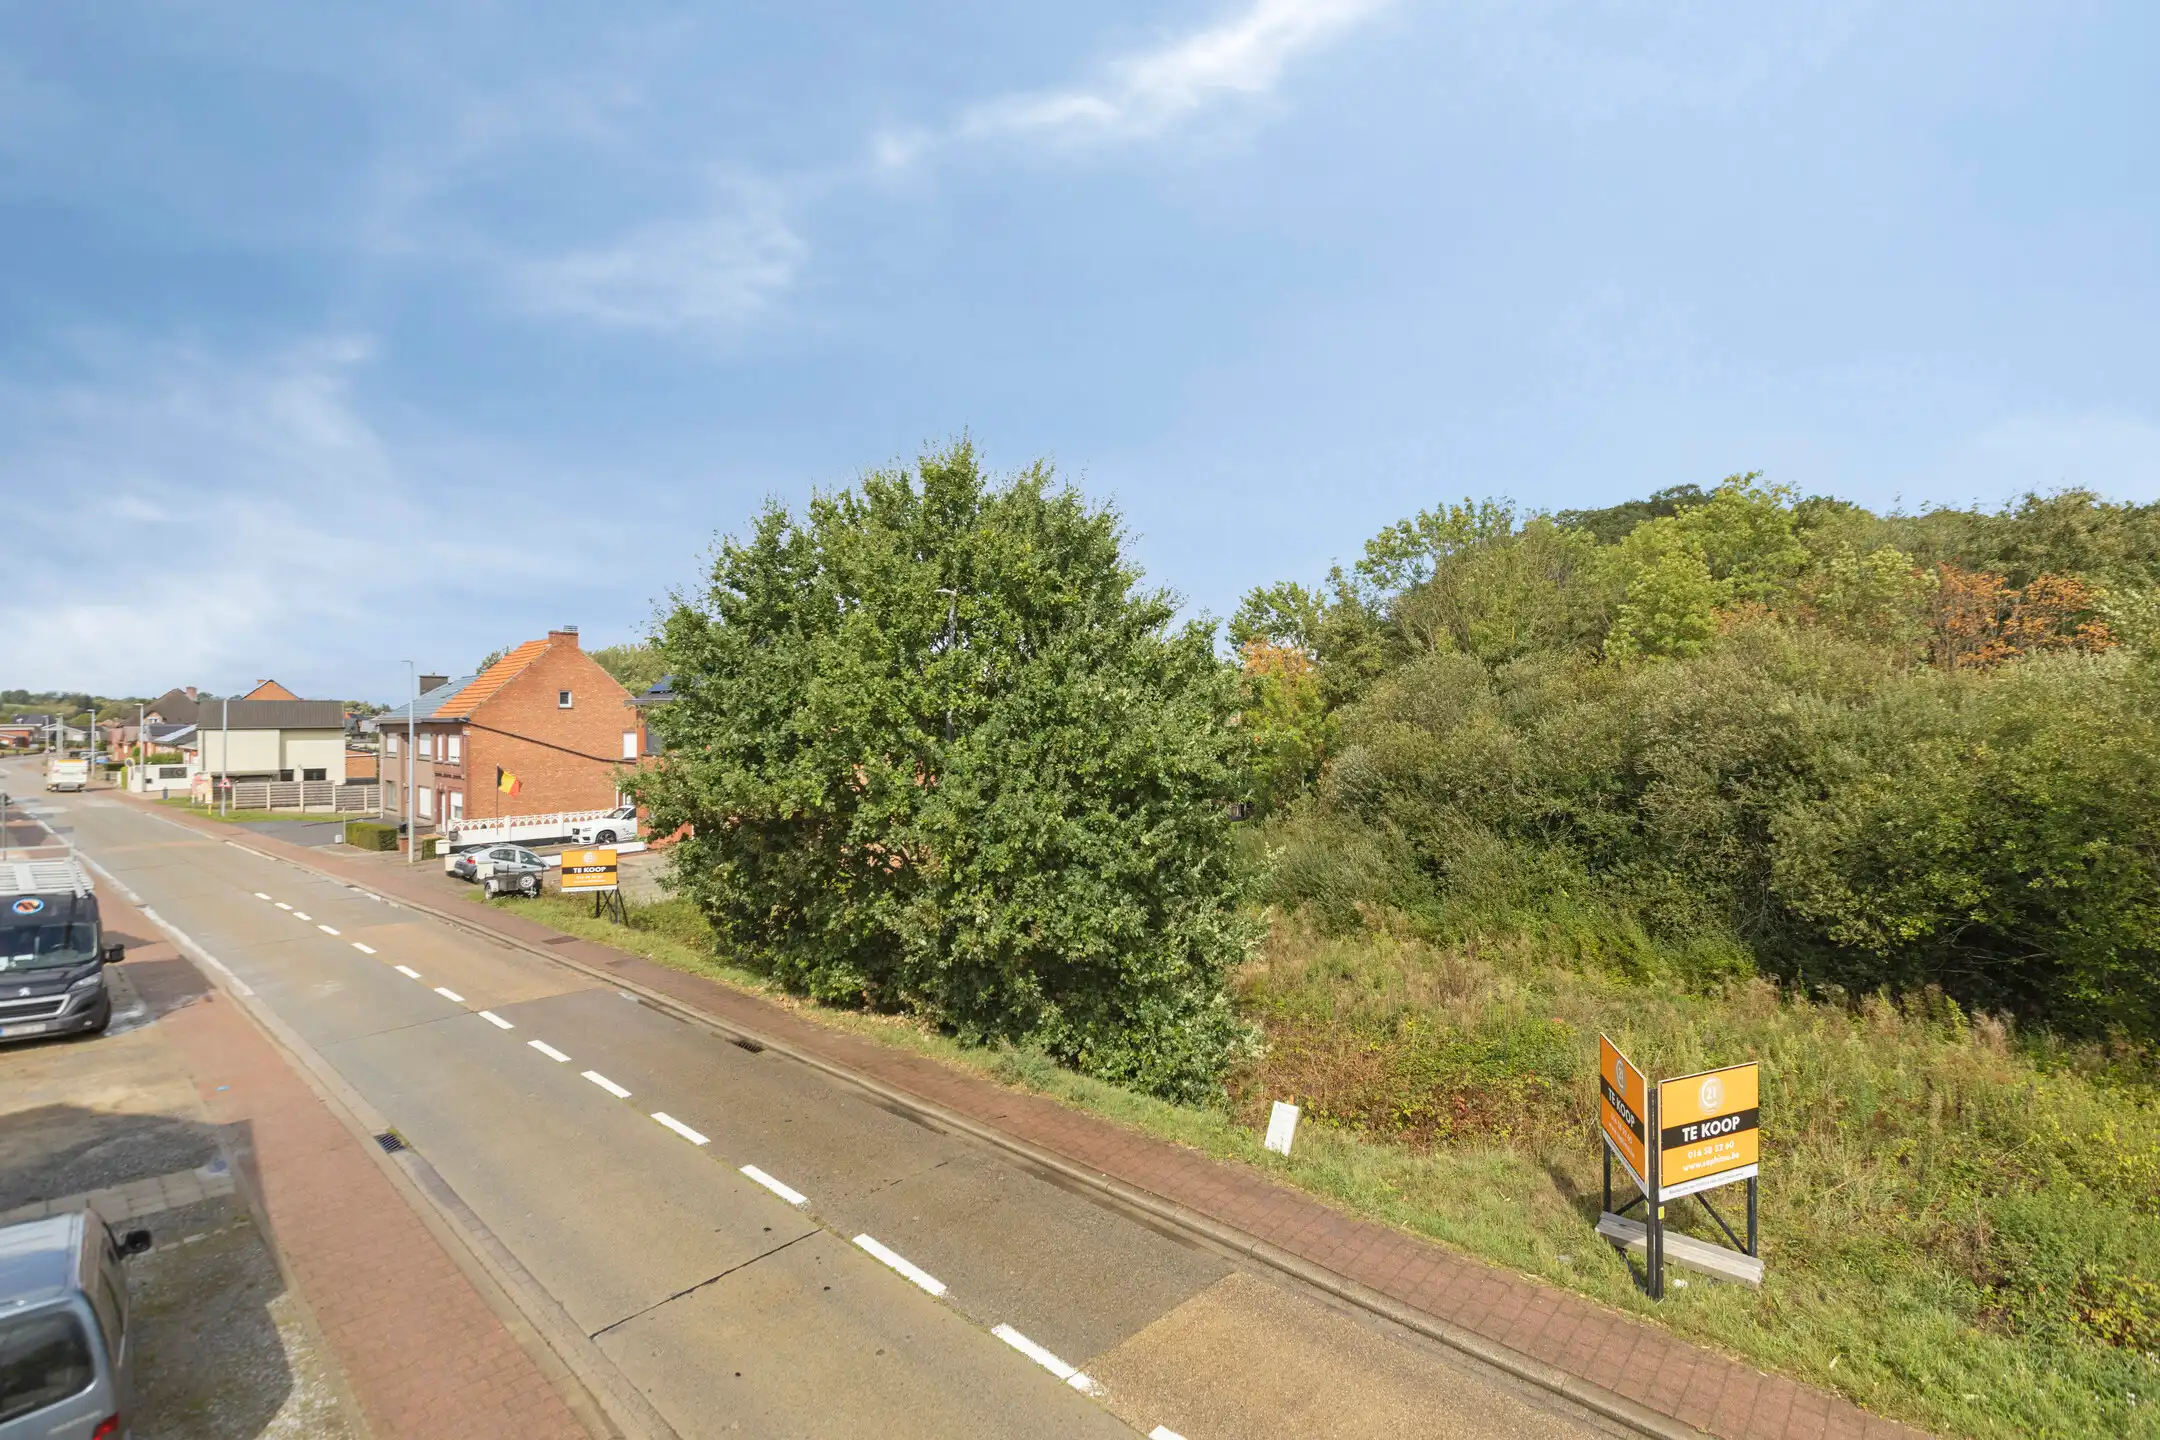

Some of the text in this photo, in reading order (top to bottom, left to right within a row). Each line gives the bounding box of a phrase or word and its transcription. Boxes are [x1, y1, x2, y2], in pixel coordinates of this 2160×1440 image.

[1608, 1087, 1616, 1106] TE
[1616, 1097, 1635, 1128] KOOP
[1682, 1115, 1741, 1142] TE KOOP
